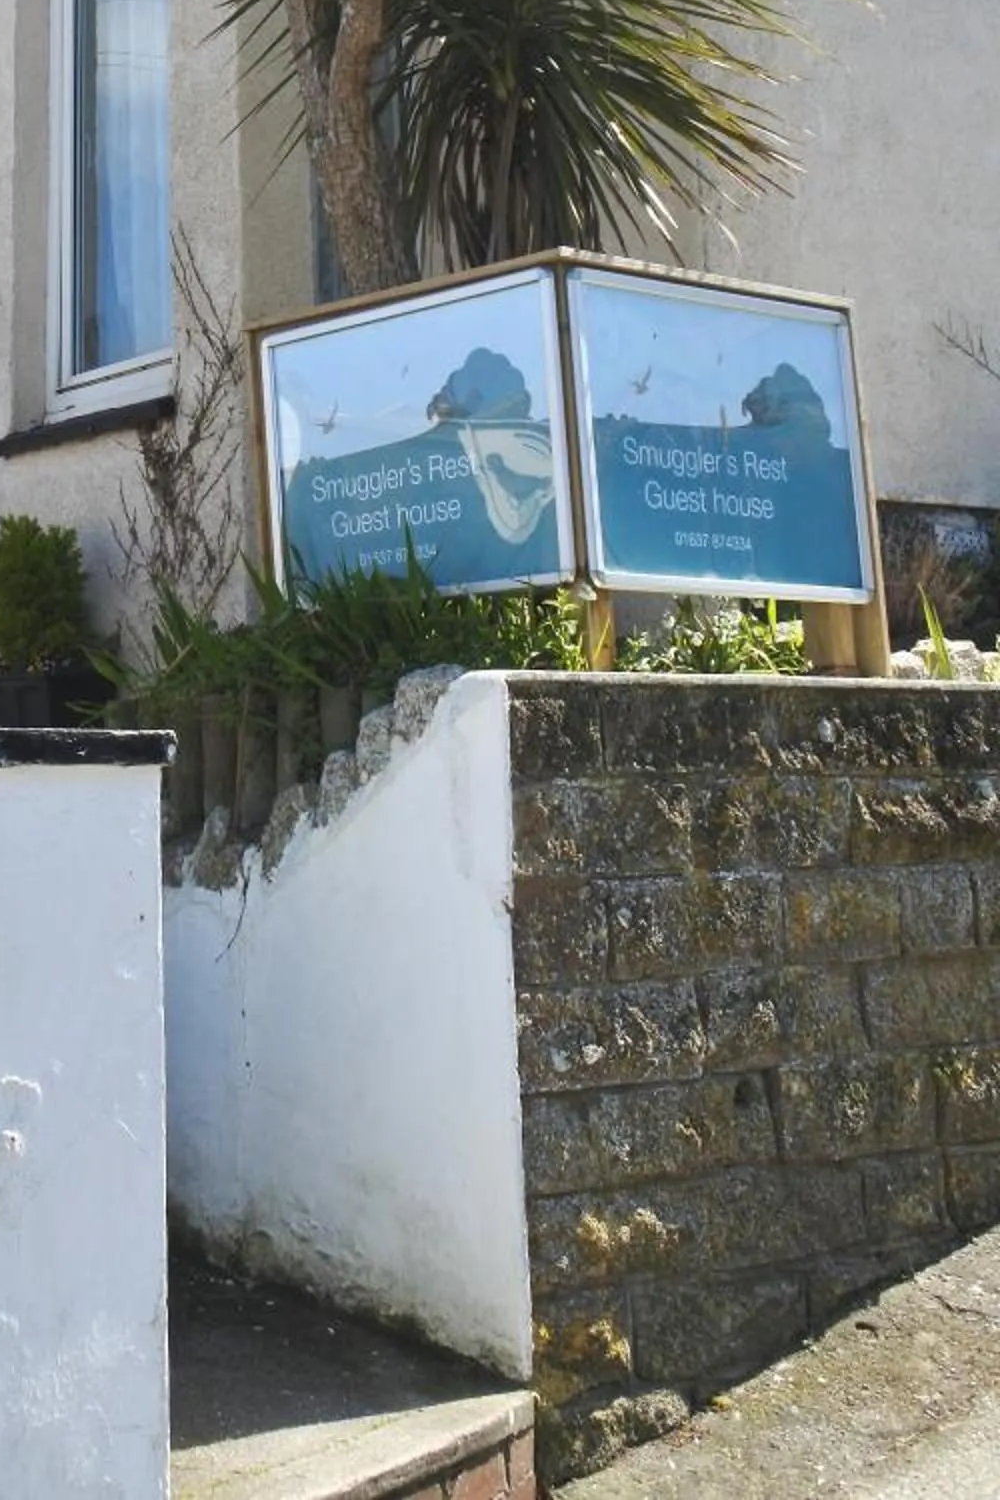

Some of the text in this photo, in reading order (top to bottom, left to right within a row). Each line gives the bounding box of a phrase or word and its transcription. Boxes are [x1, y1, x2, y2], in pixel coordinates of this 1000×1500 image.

[311, 453, 478, 502] Smuggler's Rest
[623, 436, 788, 483] Smugglers Rest
[331, 499, 462, 538] Guest house
[644, 480, 775, 520] Guest house
